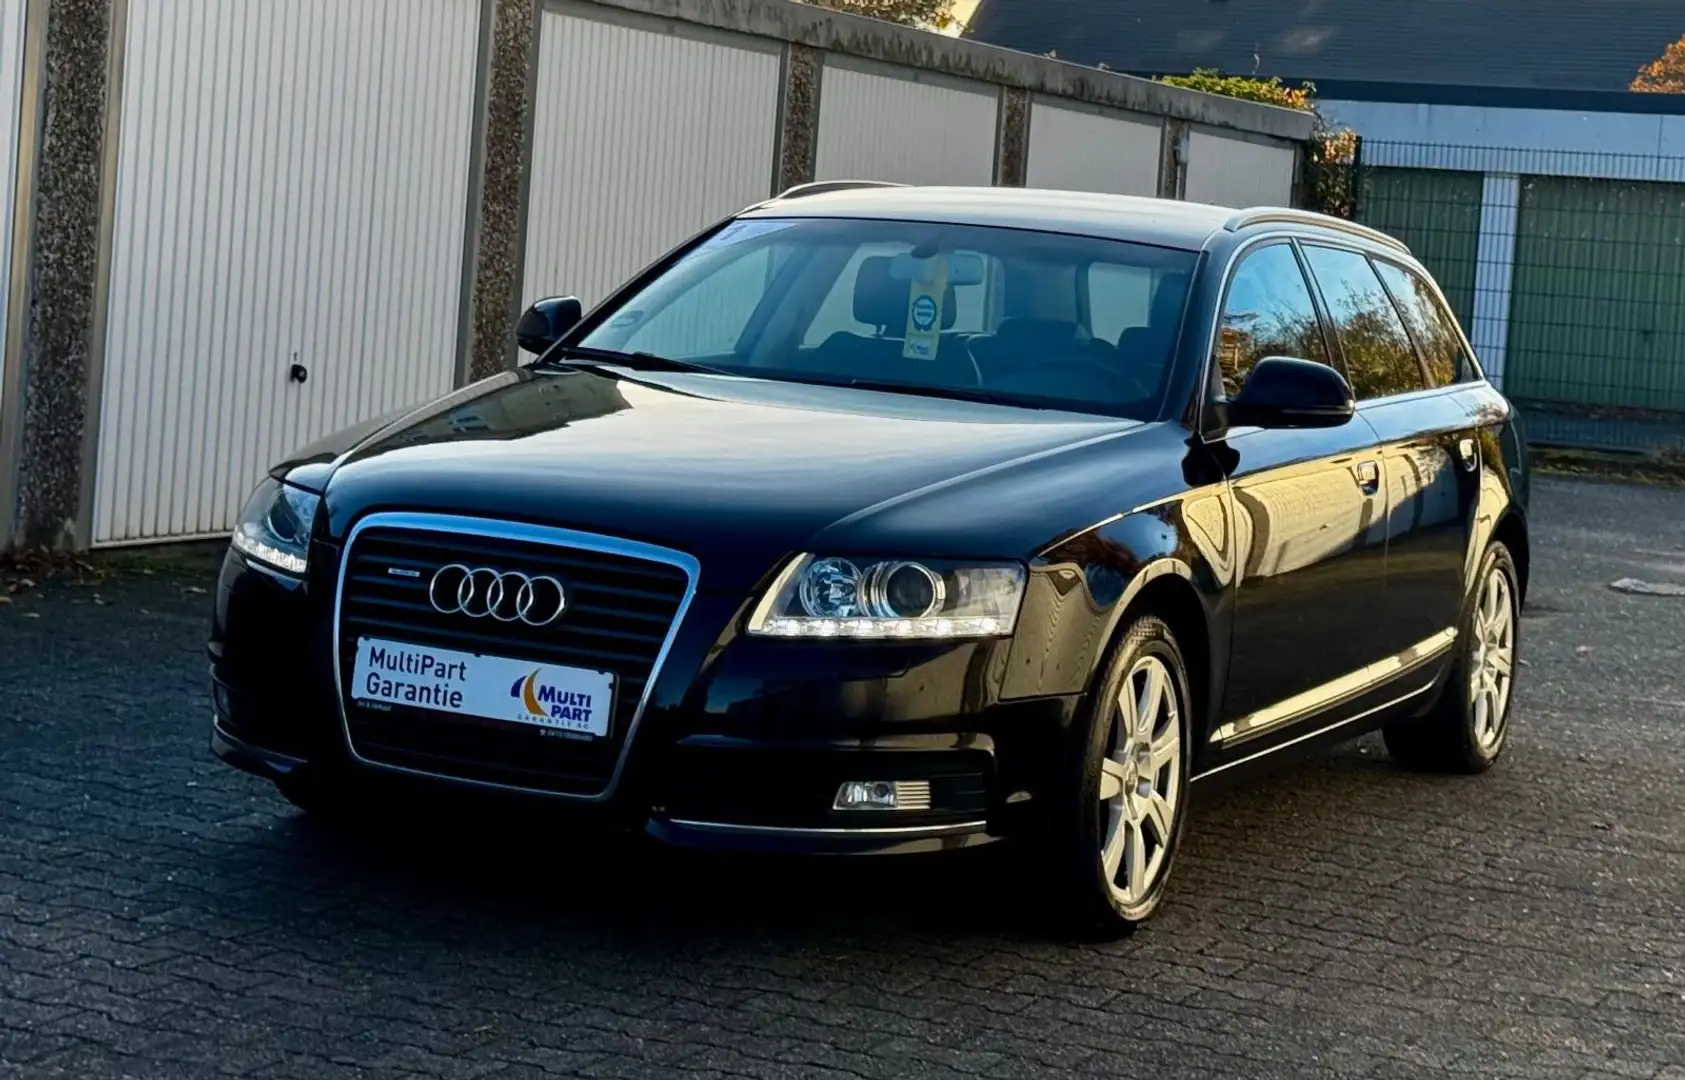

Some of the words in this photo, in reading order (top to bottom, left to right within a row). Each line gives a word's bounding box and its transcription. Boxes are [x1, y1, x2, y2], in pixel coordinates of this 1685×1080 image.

[369, 646, 467, 681] MultiPart
[366, 672, 463, 708] Garantie
[538, 684, 591, 708] MULTI
[550, 706, 592, 722] PART
